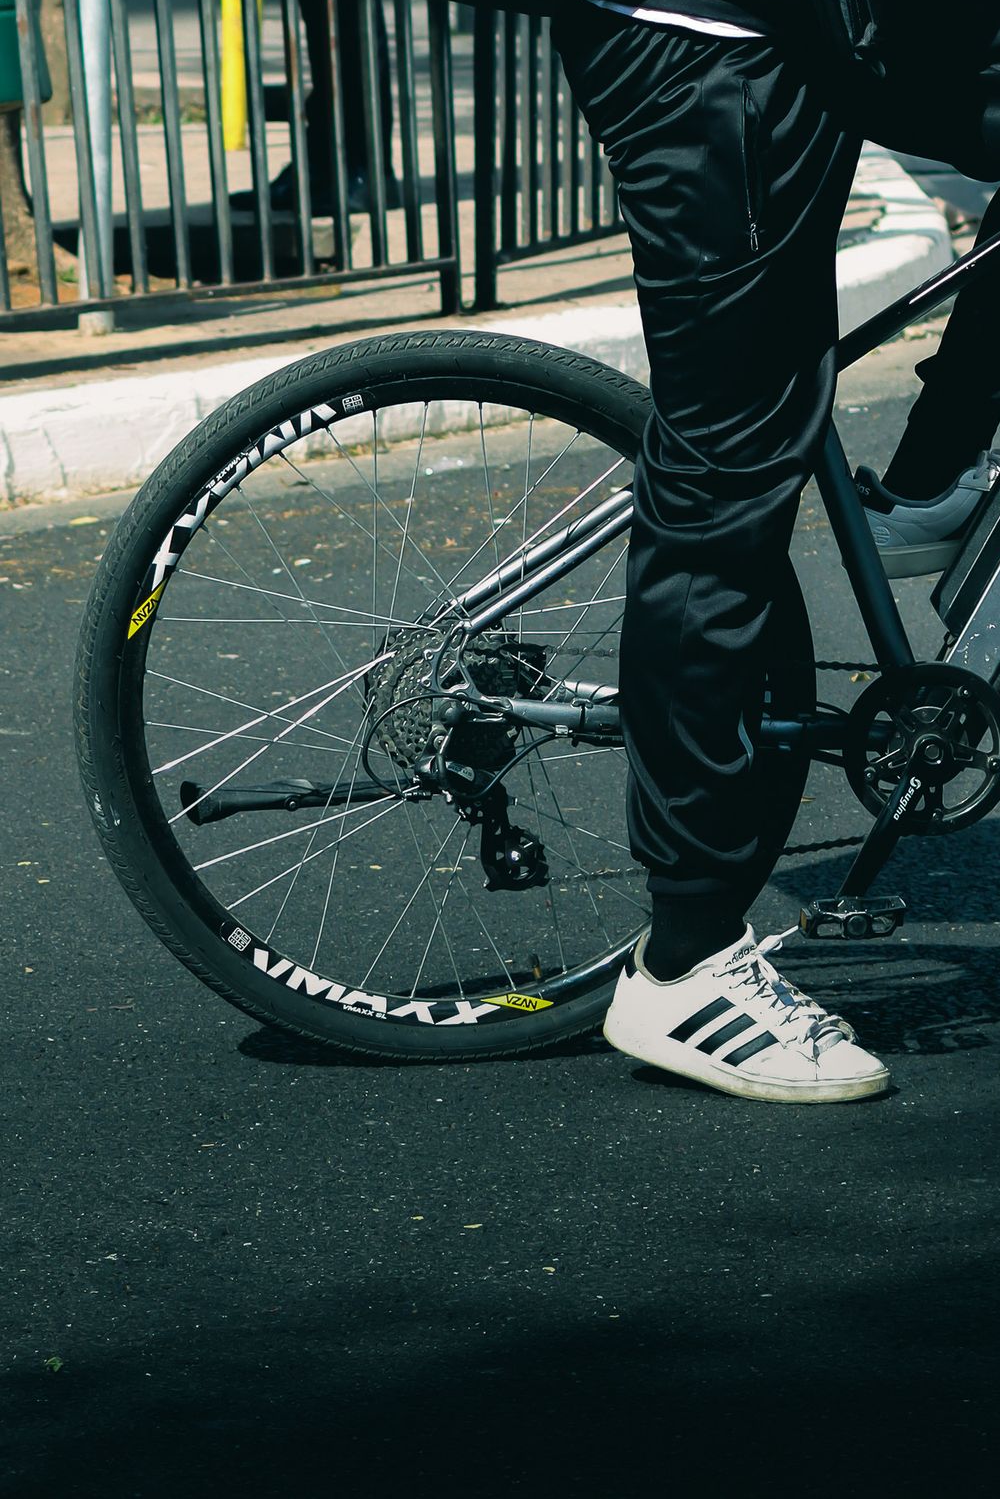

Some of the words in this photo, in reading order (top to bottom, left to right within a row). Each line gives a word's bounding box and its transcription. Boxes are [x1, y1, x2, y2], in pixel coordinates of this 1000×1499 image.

[151, 403, 337, 591] VMAXX
[131, 598, 159, 626] VZAN
[253, 948, 501, 1026] VMAXX
[506, 994, 538, 1010] VZAN
